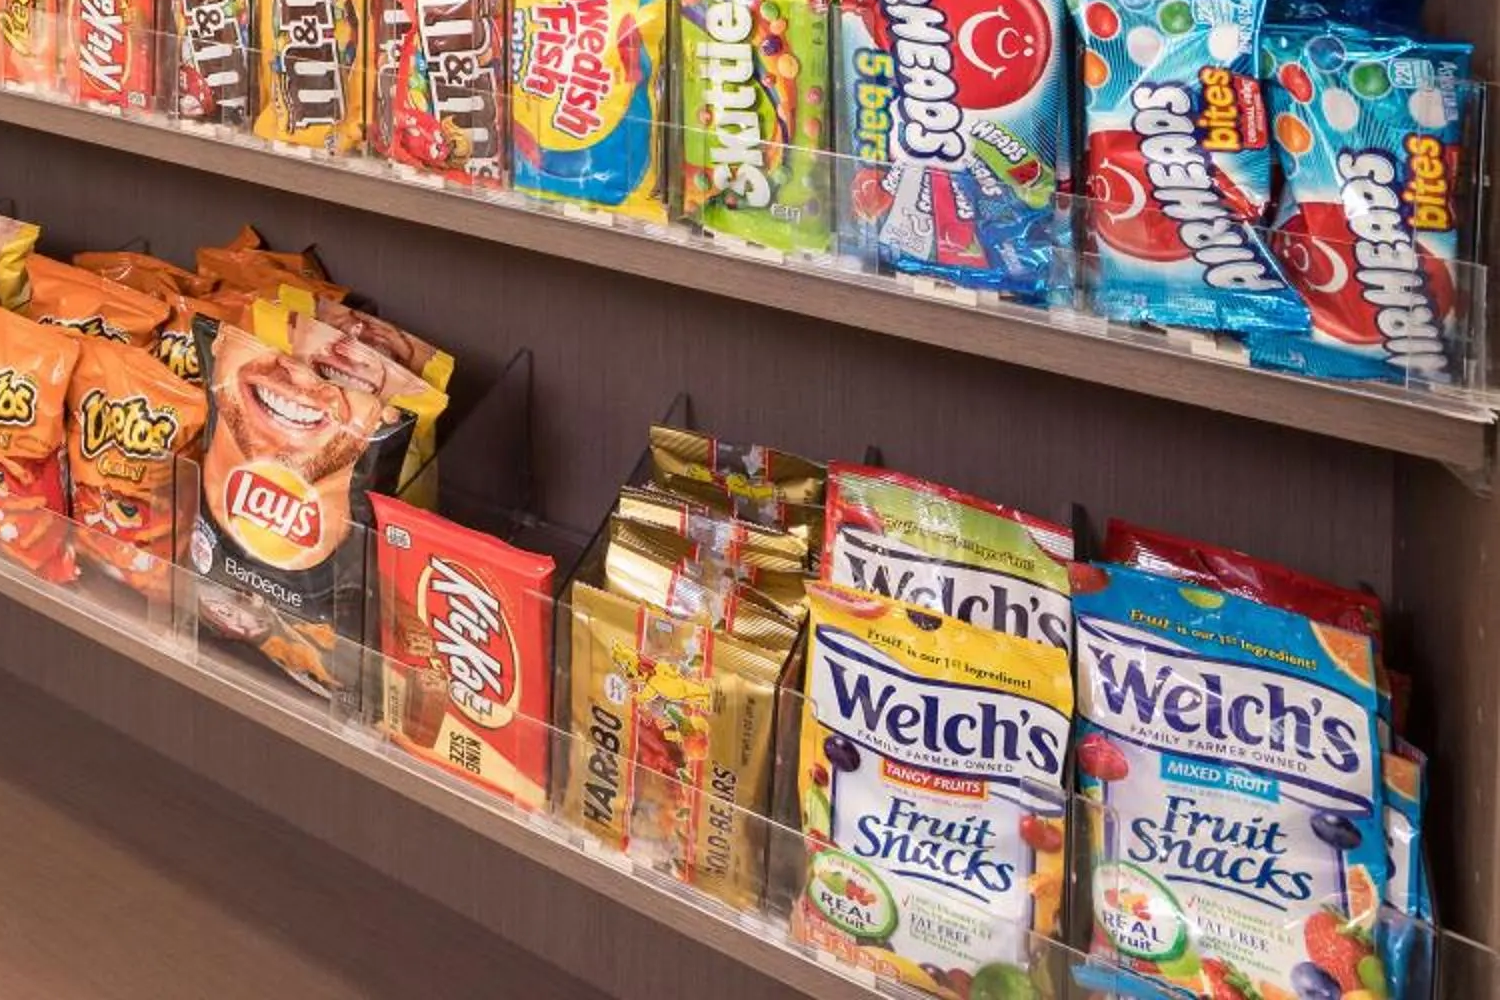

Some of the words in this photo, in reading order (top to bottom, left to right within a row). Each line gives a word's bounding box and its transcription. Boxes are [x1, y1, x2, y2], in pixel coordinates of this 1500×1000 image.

[526, 5, 576, 97] Fish
[857, 49, 895, 79] 5
[1201, 67, 1241, 152] bites
[1132, 84, 1286, 292] AIRHEADS
[1407, 135, 1451, 231] bites
[231, 471, 318, 538] Lay's
[224, 556, 302, 608] Barbecue
[867, 628, 902, 649] Fruit
[907, 647, 917, 658] is
[920, 653, 942, 665] our
[1130, 607, 1170, 629] Fruit
[1176, 623, 1189, 636] is
[1191, 628, 1215, 641] our
[823, 654, 1060, 775] Welch's
[1088, 641, 1361, 775] Welch's
[450, 731, 465, 766] SIZE
[464, 735, 481, 775] KING
[583, 704, 623, 829] HARIBO
[856, 729, 900, 753] FAMILY
[906, 749, 959, 768] FARMER
[964, 759, 1014, 774] OWNED
[1129, 723, 1181, 745] FAMILY
[1187, 738, 1247, 757] FARMER
[1252, 751, 1308, 774] OWNED
[885, 761, 932, 785] TANGY
[933, 775, 982, 794] FRUITS
[1167, 760, 1222, 782] MIXED
[1225, 770, 1273, 793] FRUIT
[885, 795, 997, 851] Fruit
[1163, 795, 1288, 855] Fruit
[853, 814, 1016, 893] Snacks
[1126, 816, 1314, 902] Snacks
[820, 890, 877, 926] REAL
[1102, 909, 1167, 945] REAL
